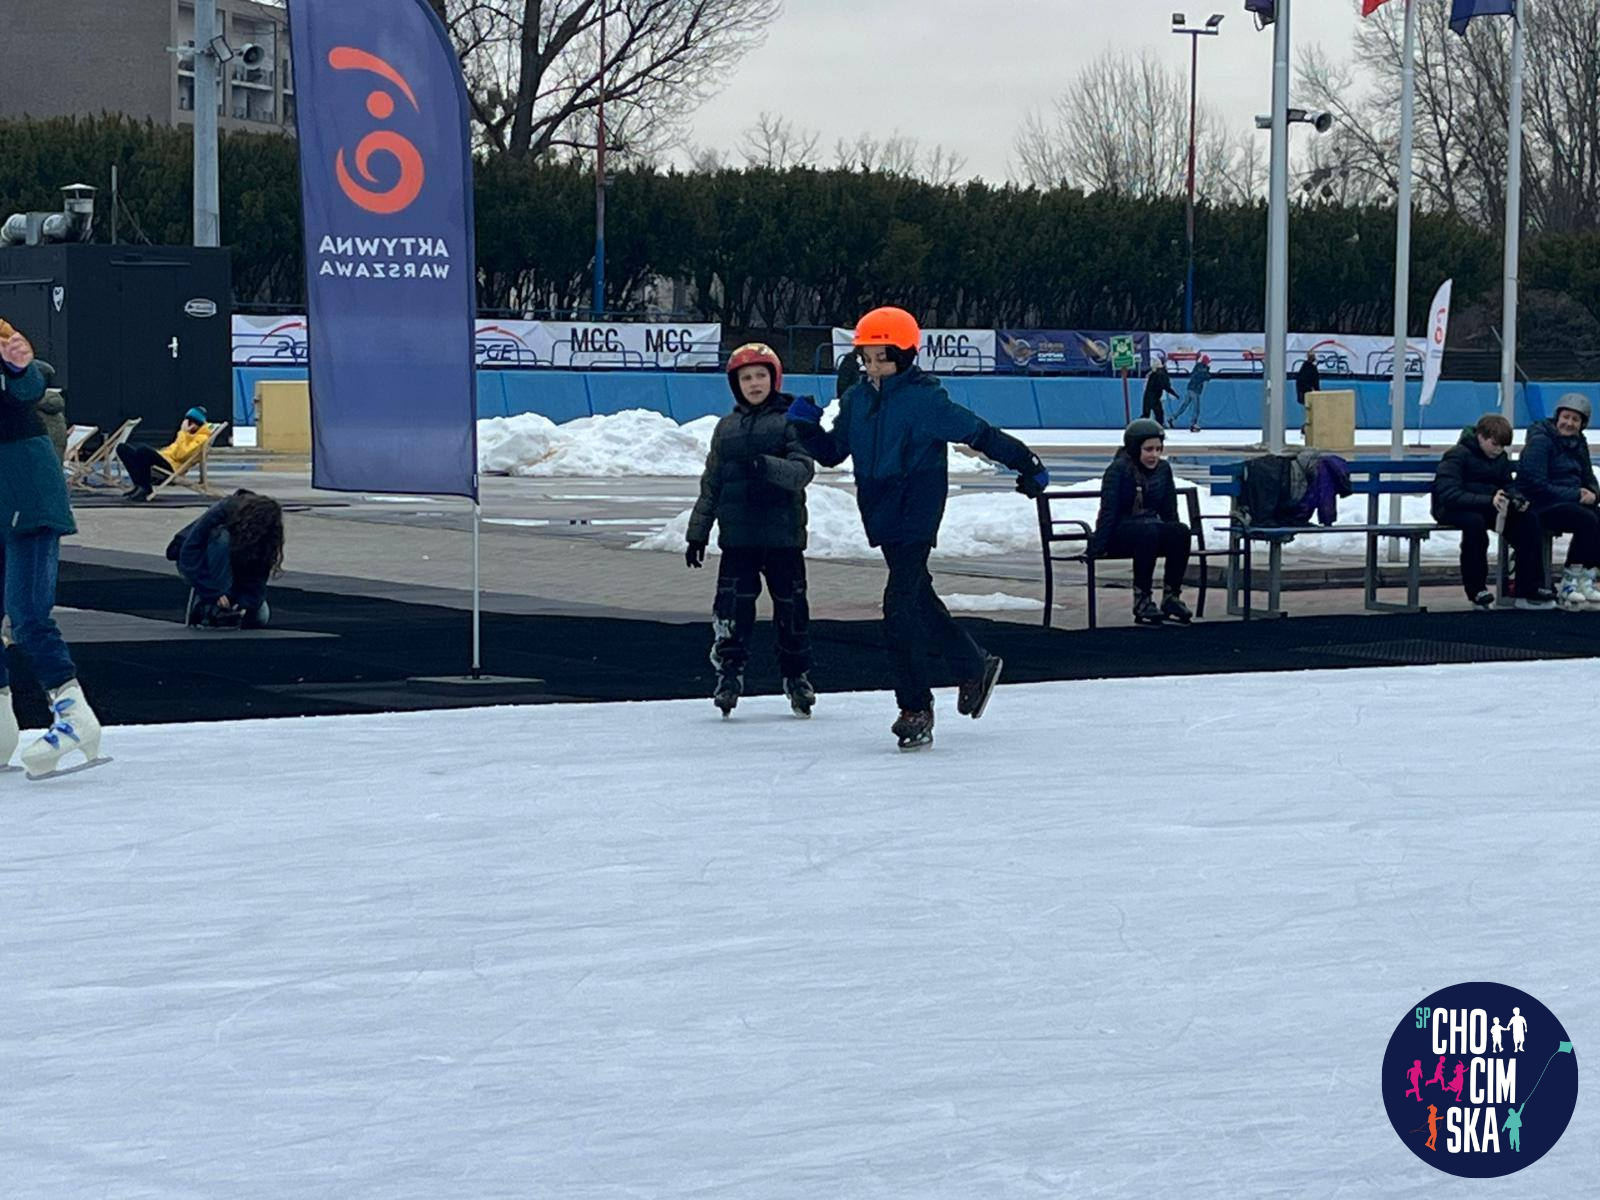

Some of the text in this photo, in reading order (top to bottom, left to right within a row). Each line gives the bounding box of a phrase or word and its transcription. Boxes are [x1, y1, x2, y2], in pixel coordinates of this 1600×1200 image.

[571, 328, 693, 353] MCC MCC
[927, 334, 969, 357] MCC
